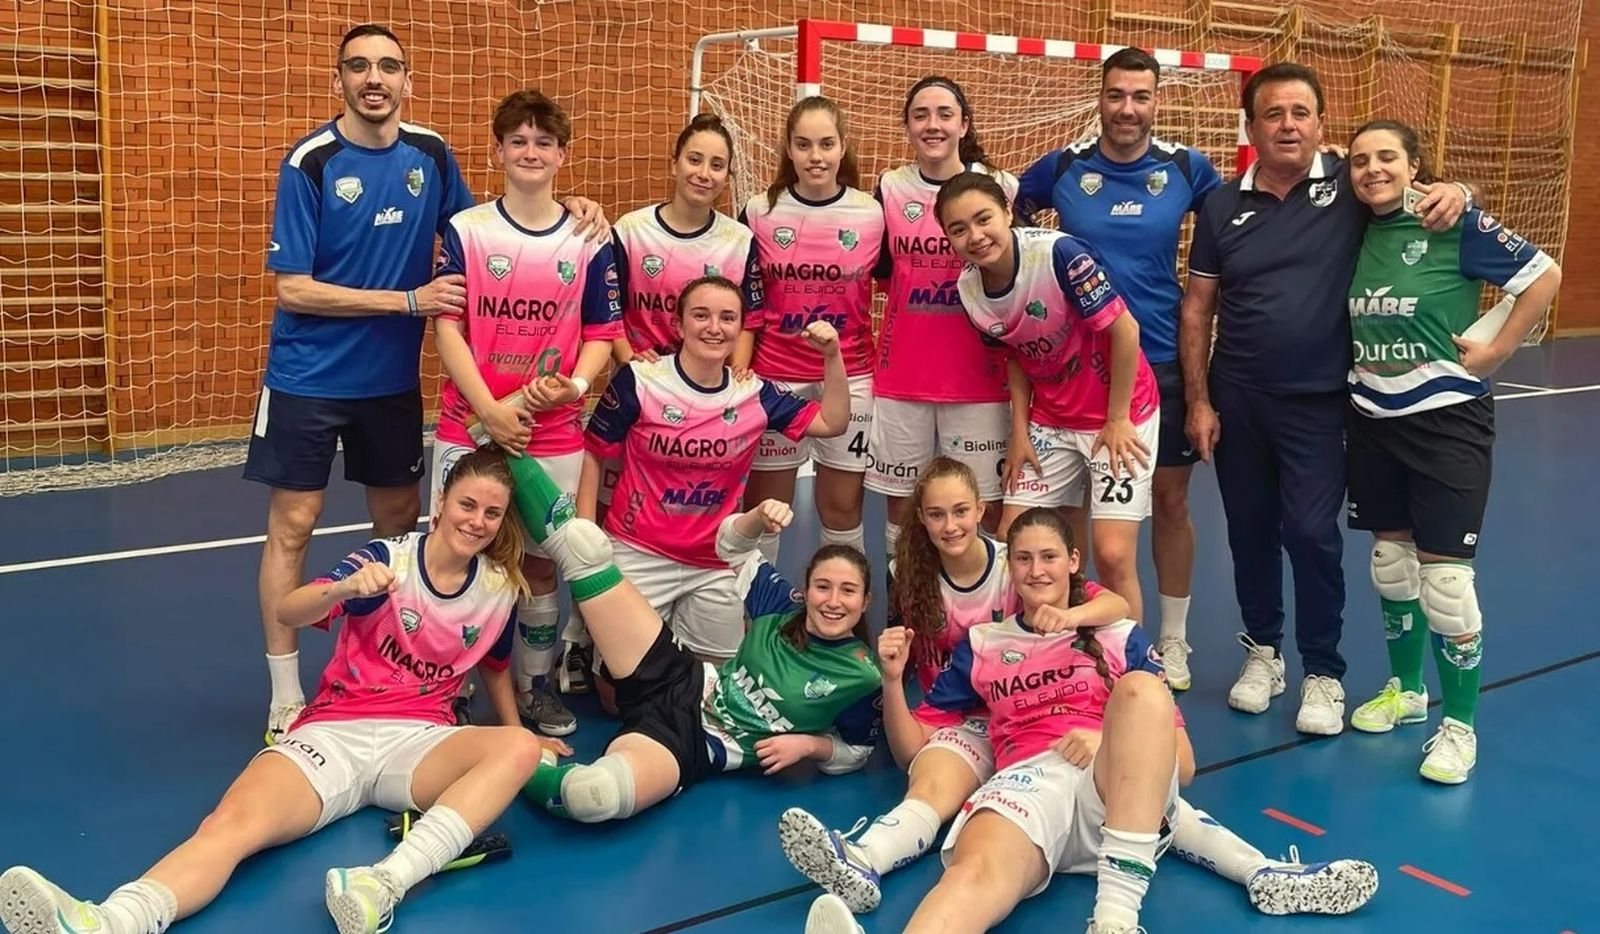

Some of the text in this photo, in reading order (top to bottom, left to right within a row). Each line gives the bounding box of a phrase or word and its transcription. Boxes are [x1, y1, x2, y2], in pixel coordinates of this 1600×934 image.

[893, 236, 958, 255] INAGR
[784, 284, 847, 295] EL EJIDO
[495, 324, 558, 336] EL EJIDO
[1016, 480, 1049, 493] nión
[1100, 475, 1134, 504] 23
[1038, 680, 1089, 703] EJIDO
